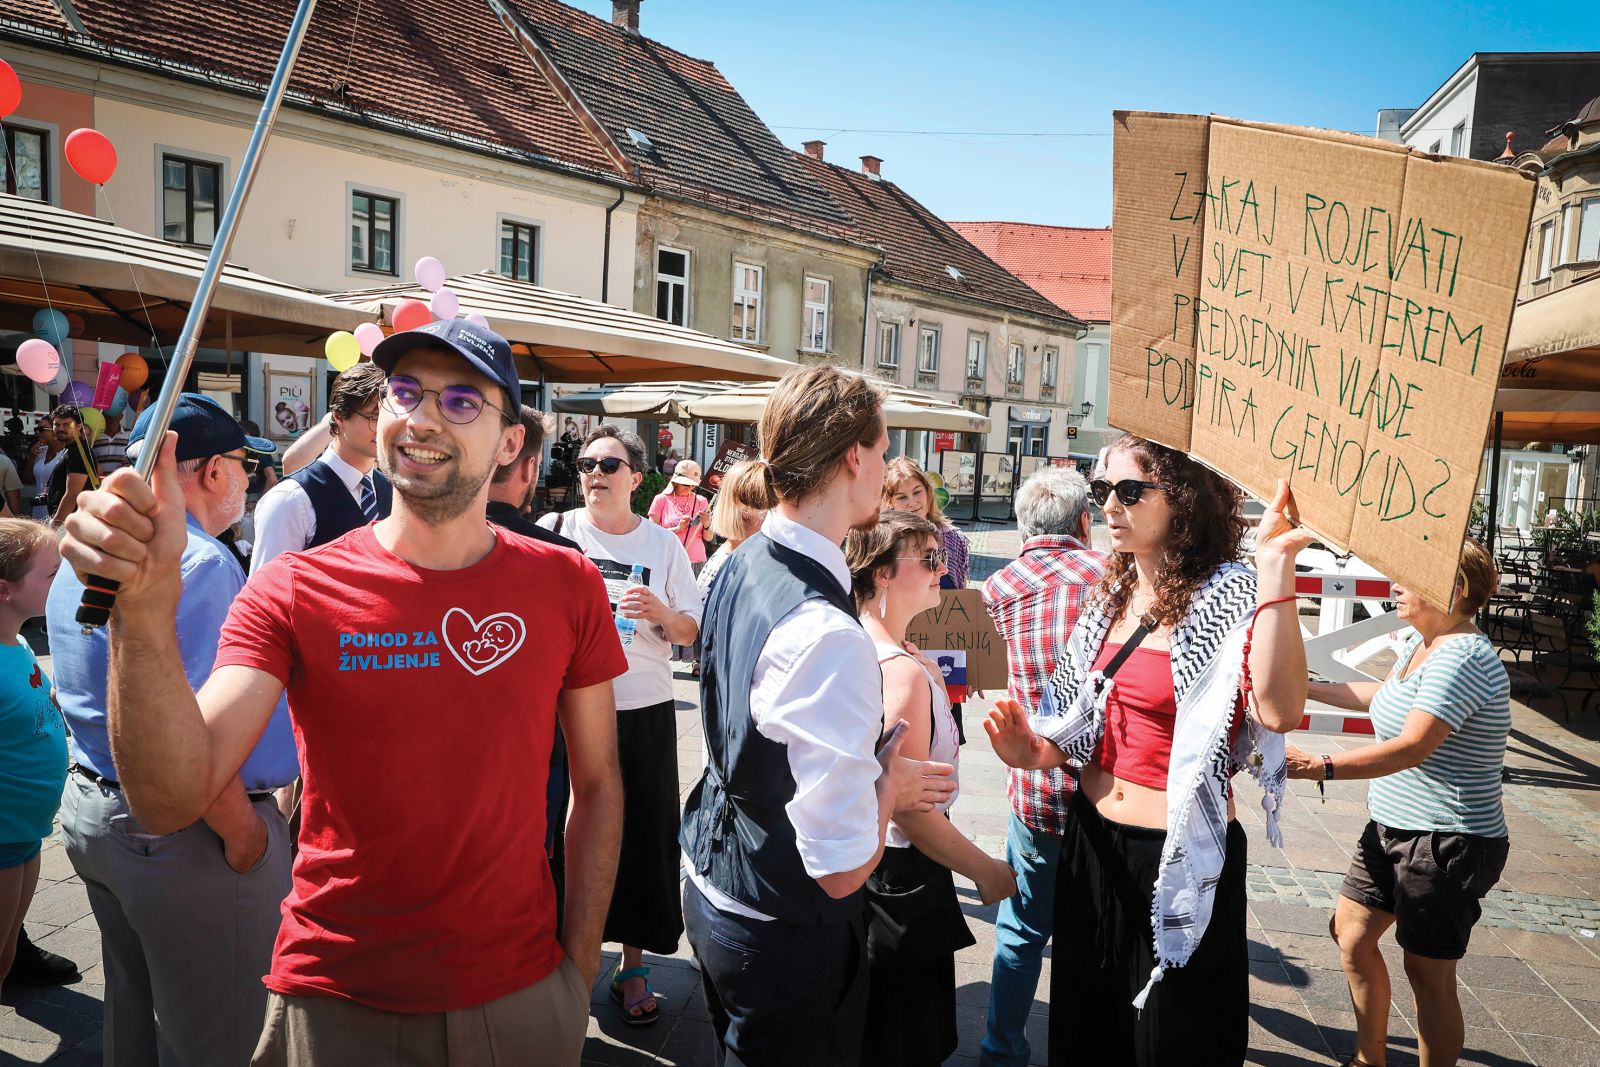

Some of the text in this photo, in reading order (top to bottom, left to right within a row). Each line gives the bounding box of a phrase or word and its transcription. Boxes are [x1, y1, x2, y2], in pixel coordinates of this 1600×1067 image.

[1170, 172, 1462, 297] ZAKAJ ROJEVATI
[1173, 234, 1483, 376] V SVET, V KATEREM
[460, 329, 495, 355] POHOD ZA
[1174, 294, 1423, 438] PREDSEDNIK VLADE
[280, 385, 302, 397] PIÙ
[706, 422, 716, 447] CAM
[1145, 347, 1451, 541] PODPIRA GENOCID?
[339, 631, 438, 648] POHOD ZA
[945, 631, 991, 656] KNJIG
[338, 652, 440, 671] ŽIVLJENJE
